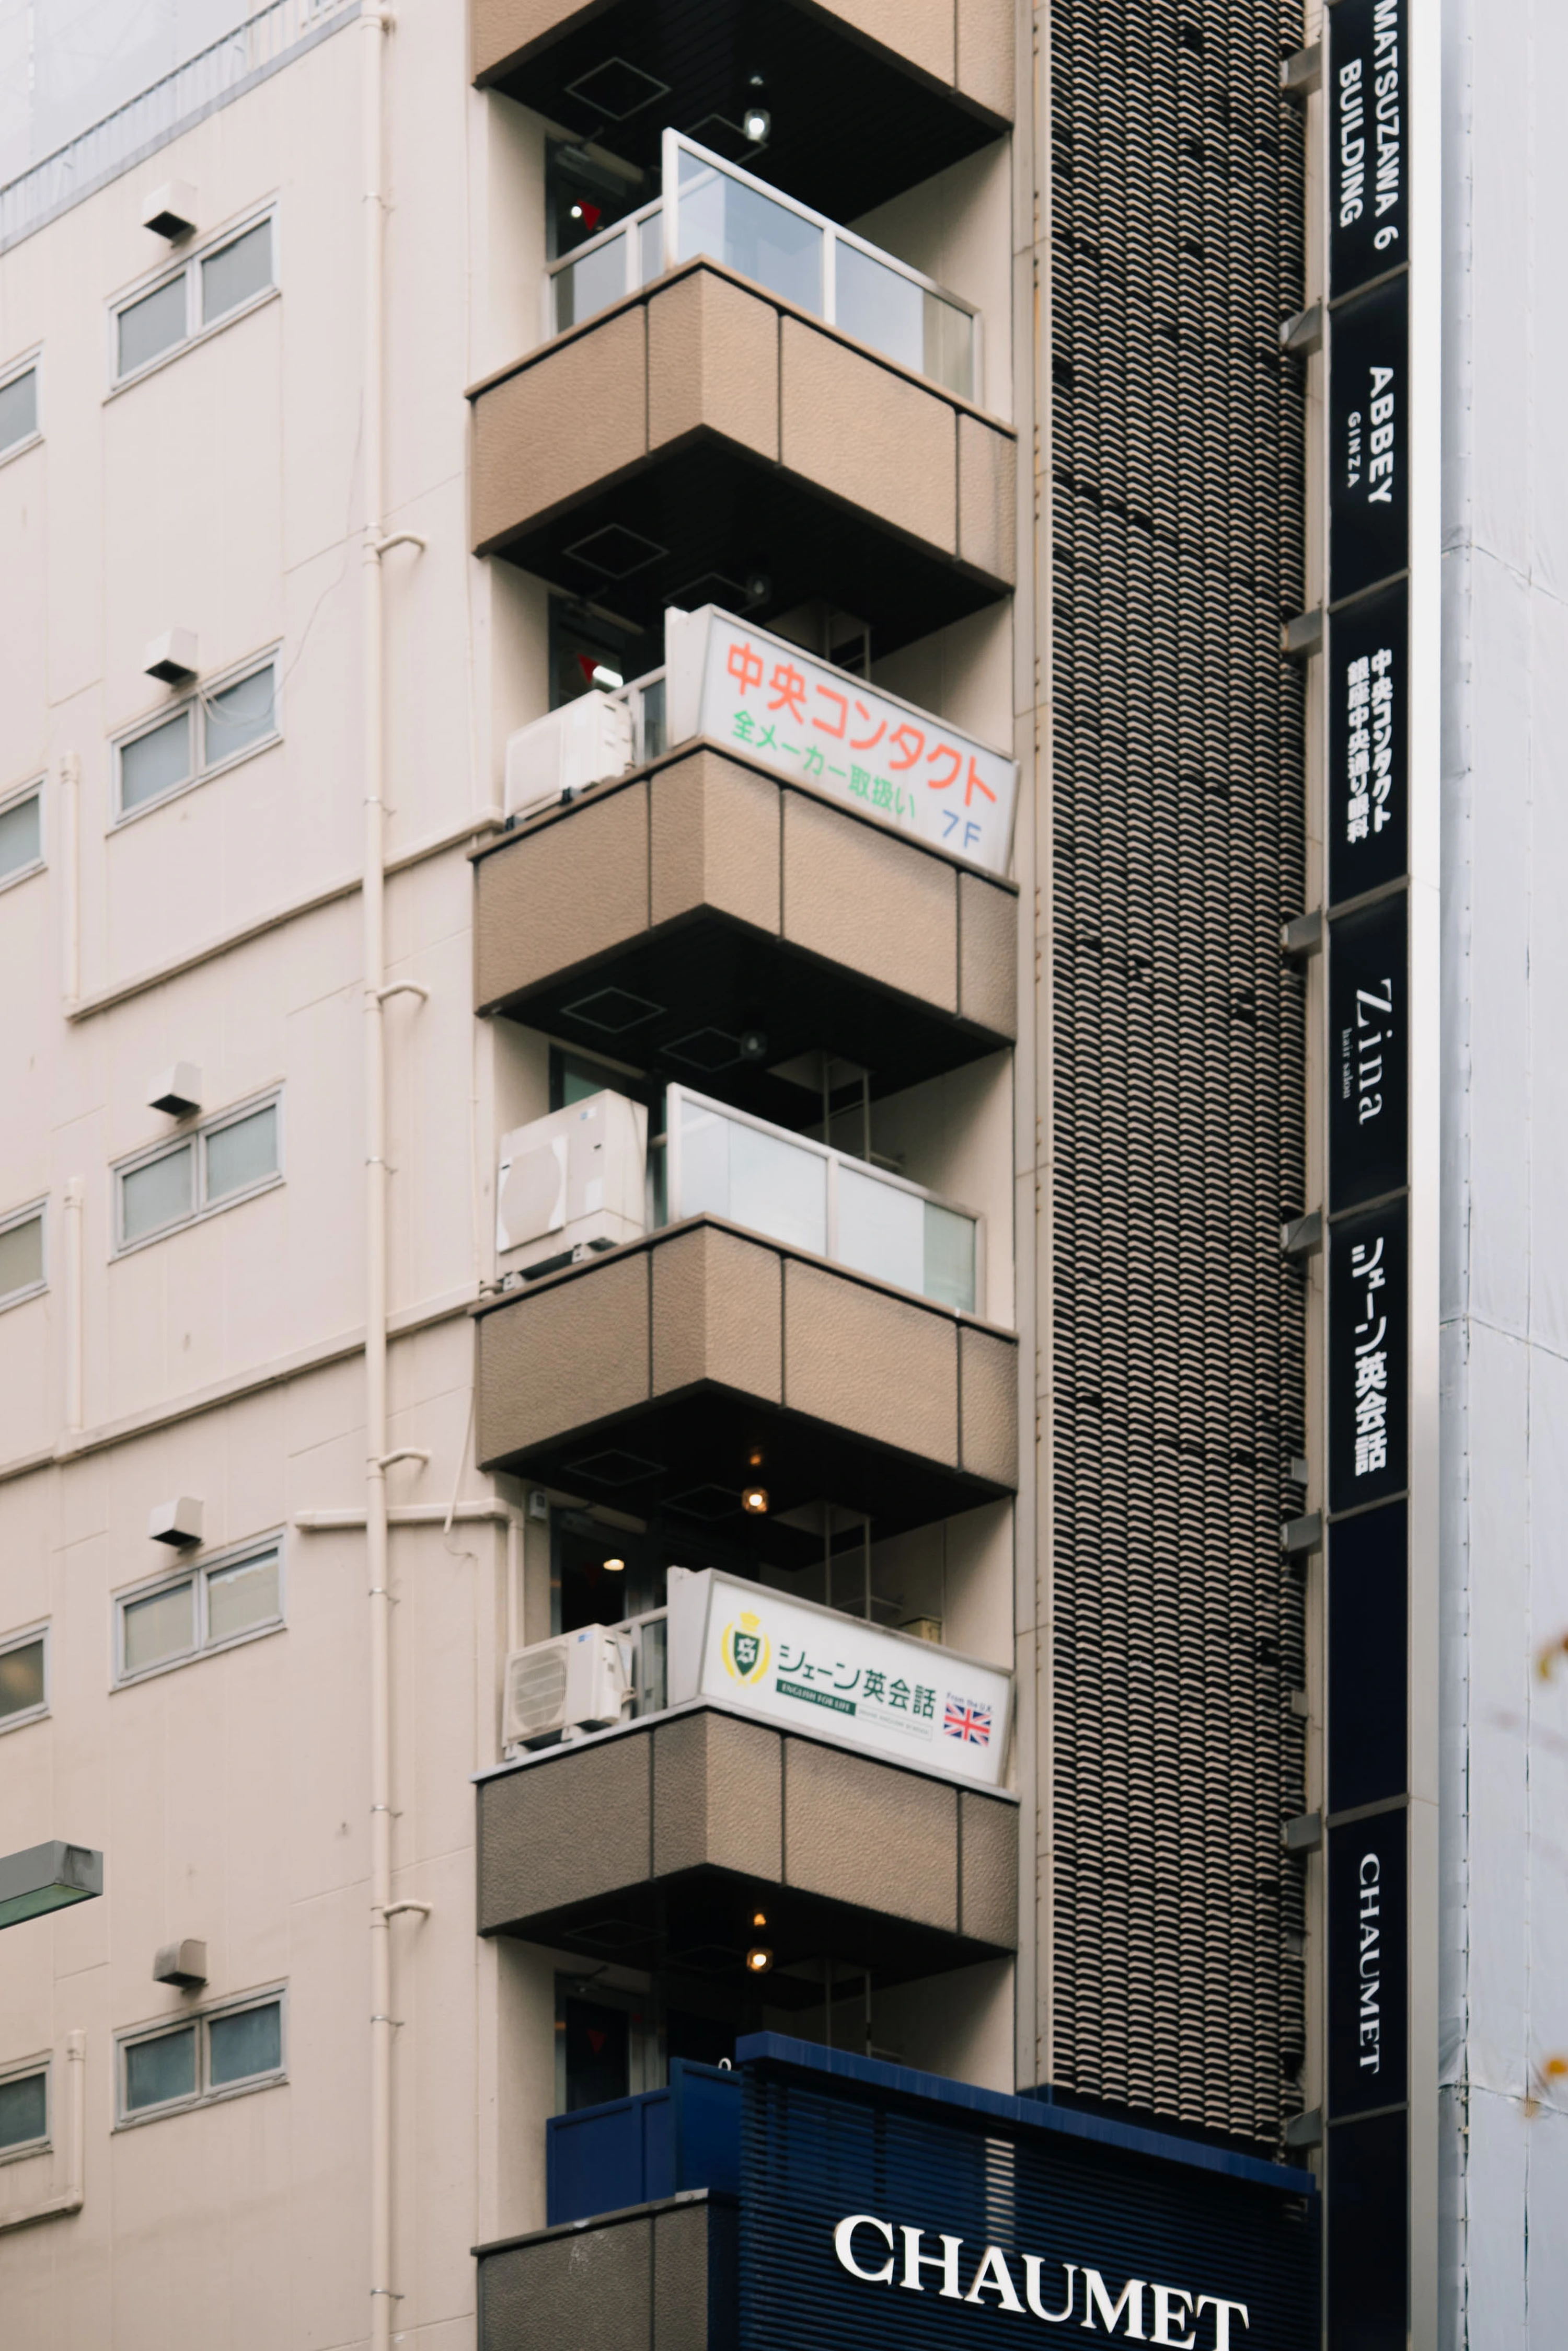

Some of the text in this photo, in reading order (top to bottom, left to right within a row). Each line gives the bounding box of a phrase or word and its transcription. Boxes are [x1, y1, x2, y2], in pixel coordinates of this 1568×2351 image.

[1340, 59, 1365, 227] BUILDING
[1374, 0, 1399, 250] MATSUZAWA 6
[1347, 411, 1361, 488] GINZA
[1368, 366, 1394, 503] ABBEY
[727, 642, 997, 807] 中央コンタクト
[732, 710, 915, 819] 全メーカー取扱い
[1371, 648, 1393, 833] 中央コンタクト
[943, 810, 982, 848] 7F
[1342, 1028, 1353, 1099] hair salon
[1356, 978, 1392, 1125] Zina
[1352, 1237, 1387, 1476] シェーン英会話
[778, 1644, 936, 1719] シェーン英会話
[1359, 1853, 1380, 2074] CHAUMET
[833, 2215, 1250, 2351] CHAUMET
